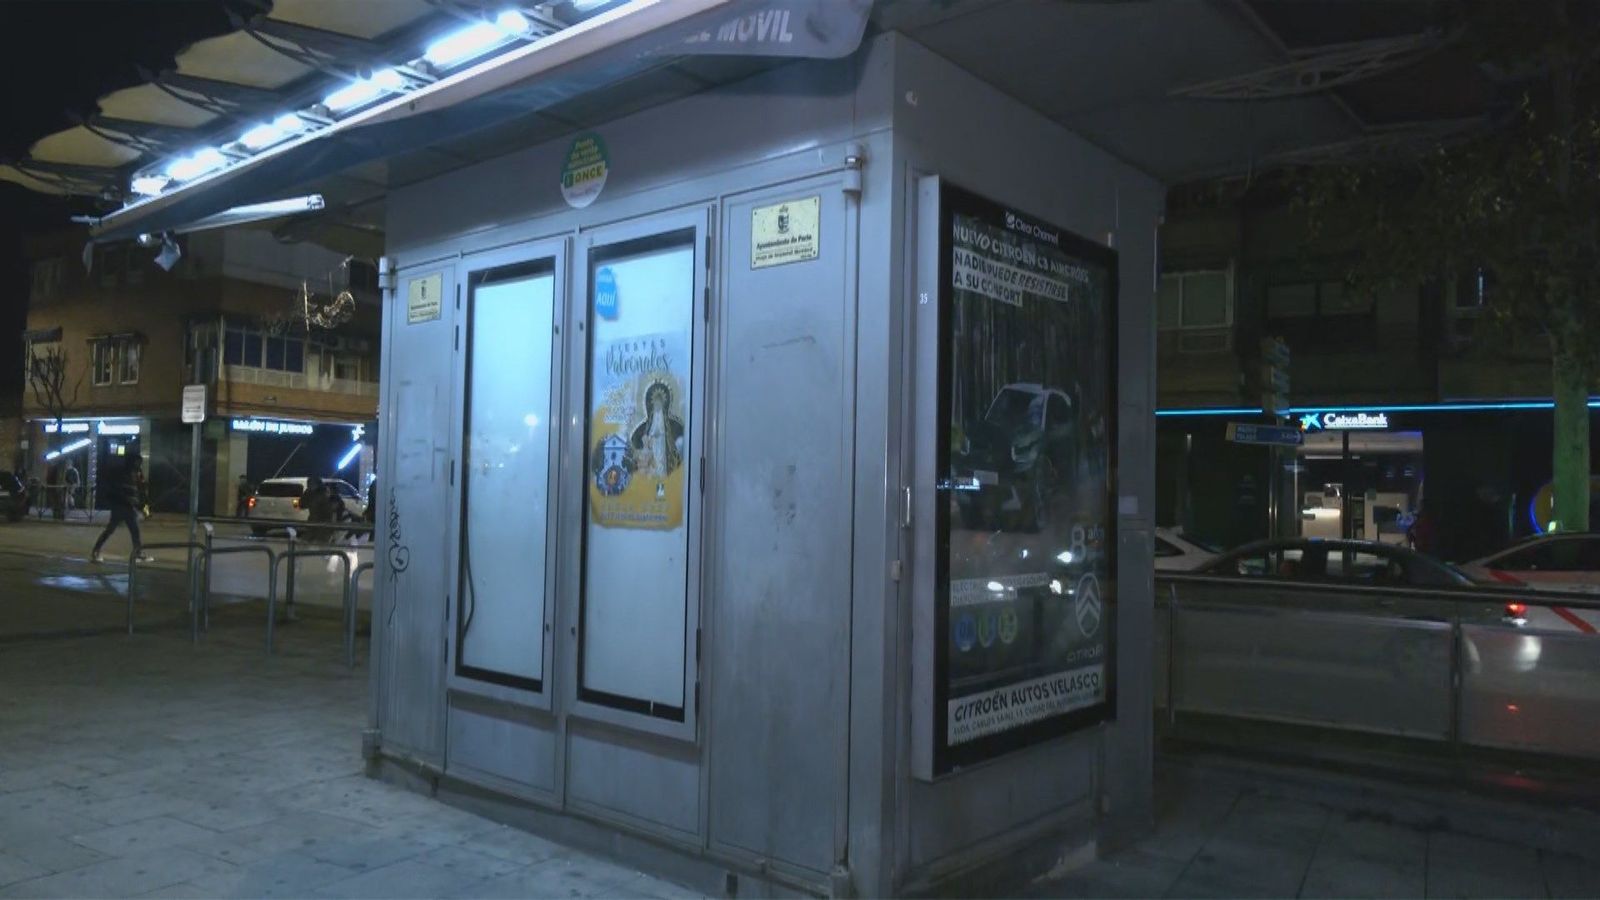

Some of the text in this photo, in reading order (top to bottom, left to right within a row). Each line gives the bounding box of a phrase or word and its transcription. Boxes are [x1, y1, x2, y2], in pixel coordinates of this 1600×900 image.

[575, 165, 602, 183] ONCE
[952, 223, 991, 250] NUEVO
[1033, 224, 1059, 245] Channel
[954, 250, 986, 274] NADIE
[986, 263, 1018, 284] PUEDE
[954, 271, 1021, 304] A SU CONFORT
[1323, 413, 1388, 427] CaixaBank
[954, 689, 1009, 722] CITROËN
[1011, 684, 1050, 708] AUTOS
[1050, 672, 1099, 697] VELASCO
